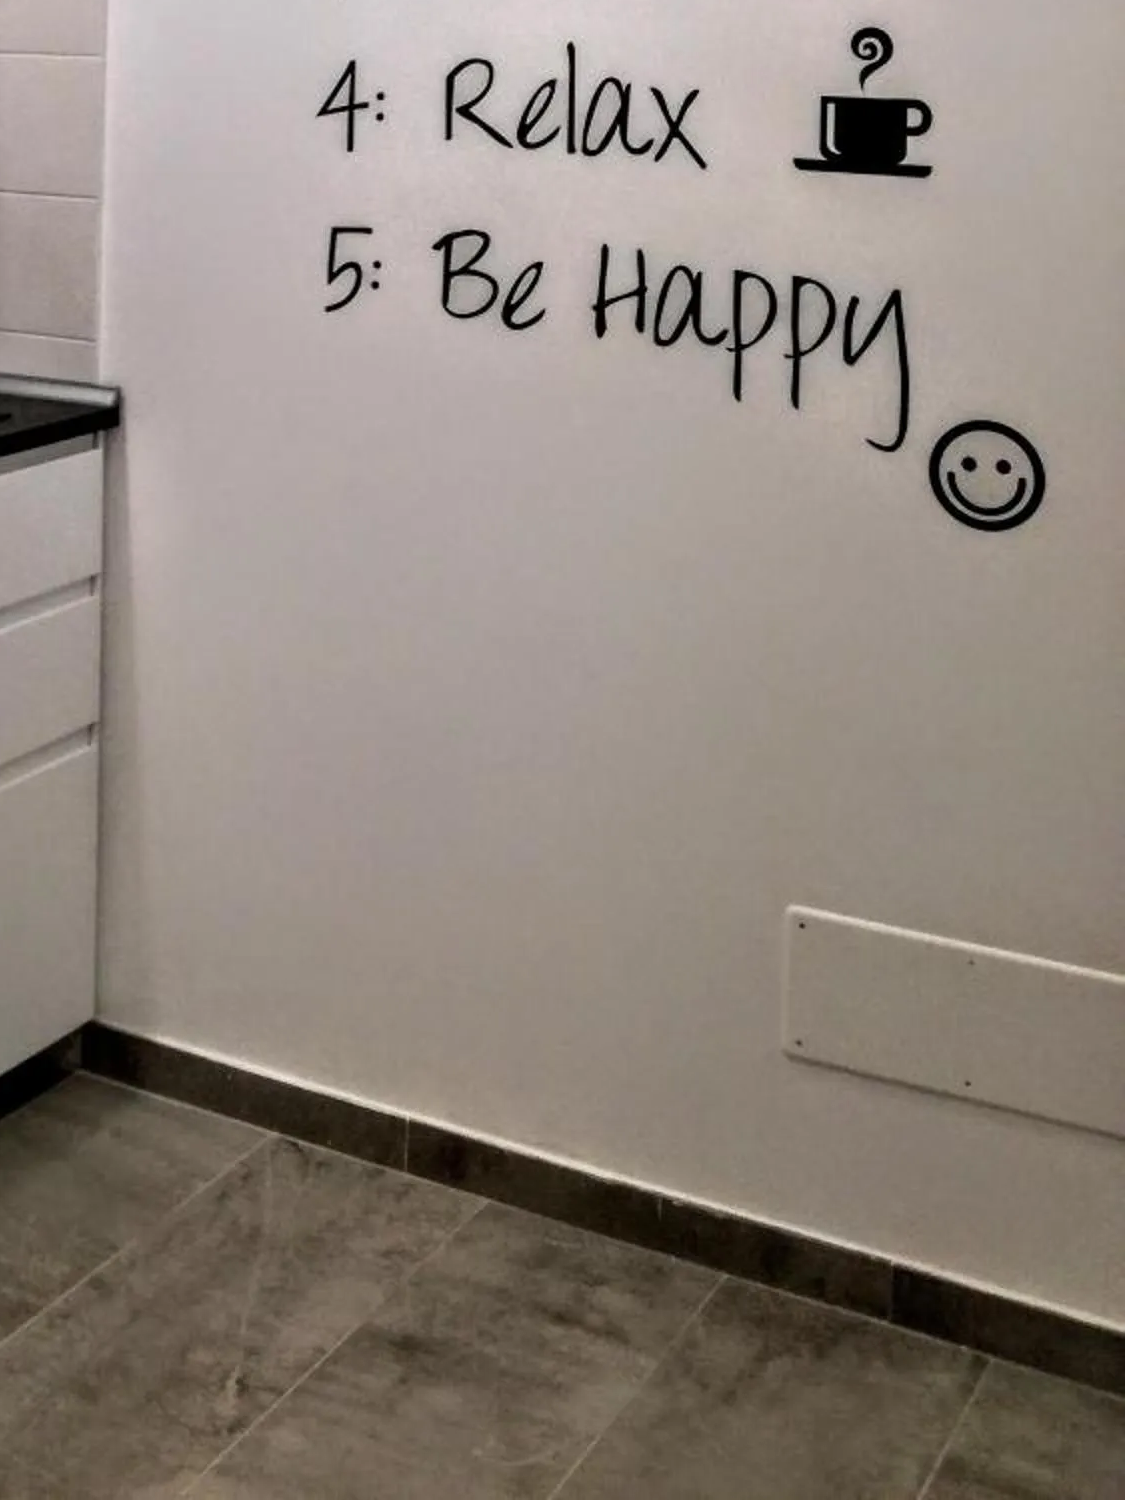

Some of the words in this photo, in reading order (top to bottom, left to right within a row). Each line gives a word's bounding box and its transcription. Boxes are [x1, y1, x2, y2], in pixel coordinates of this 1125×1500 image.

[316, 59, 385, 153] 4:
[444, 41, 708, 170] Relax
[324, 225, 383, 313] 5:
[431, 229, 546, 331] Be
[592, 243, 911, 453] Happy
